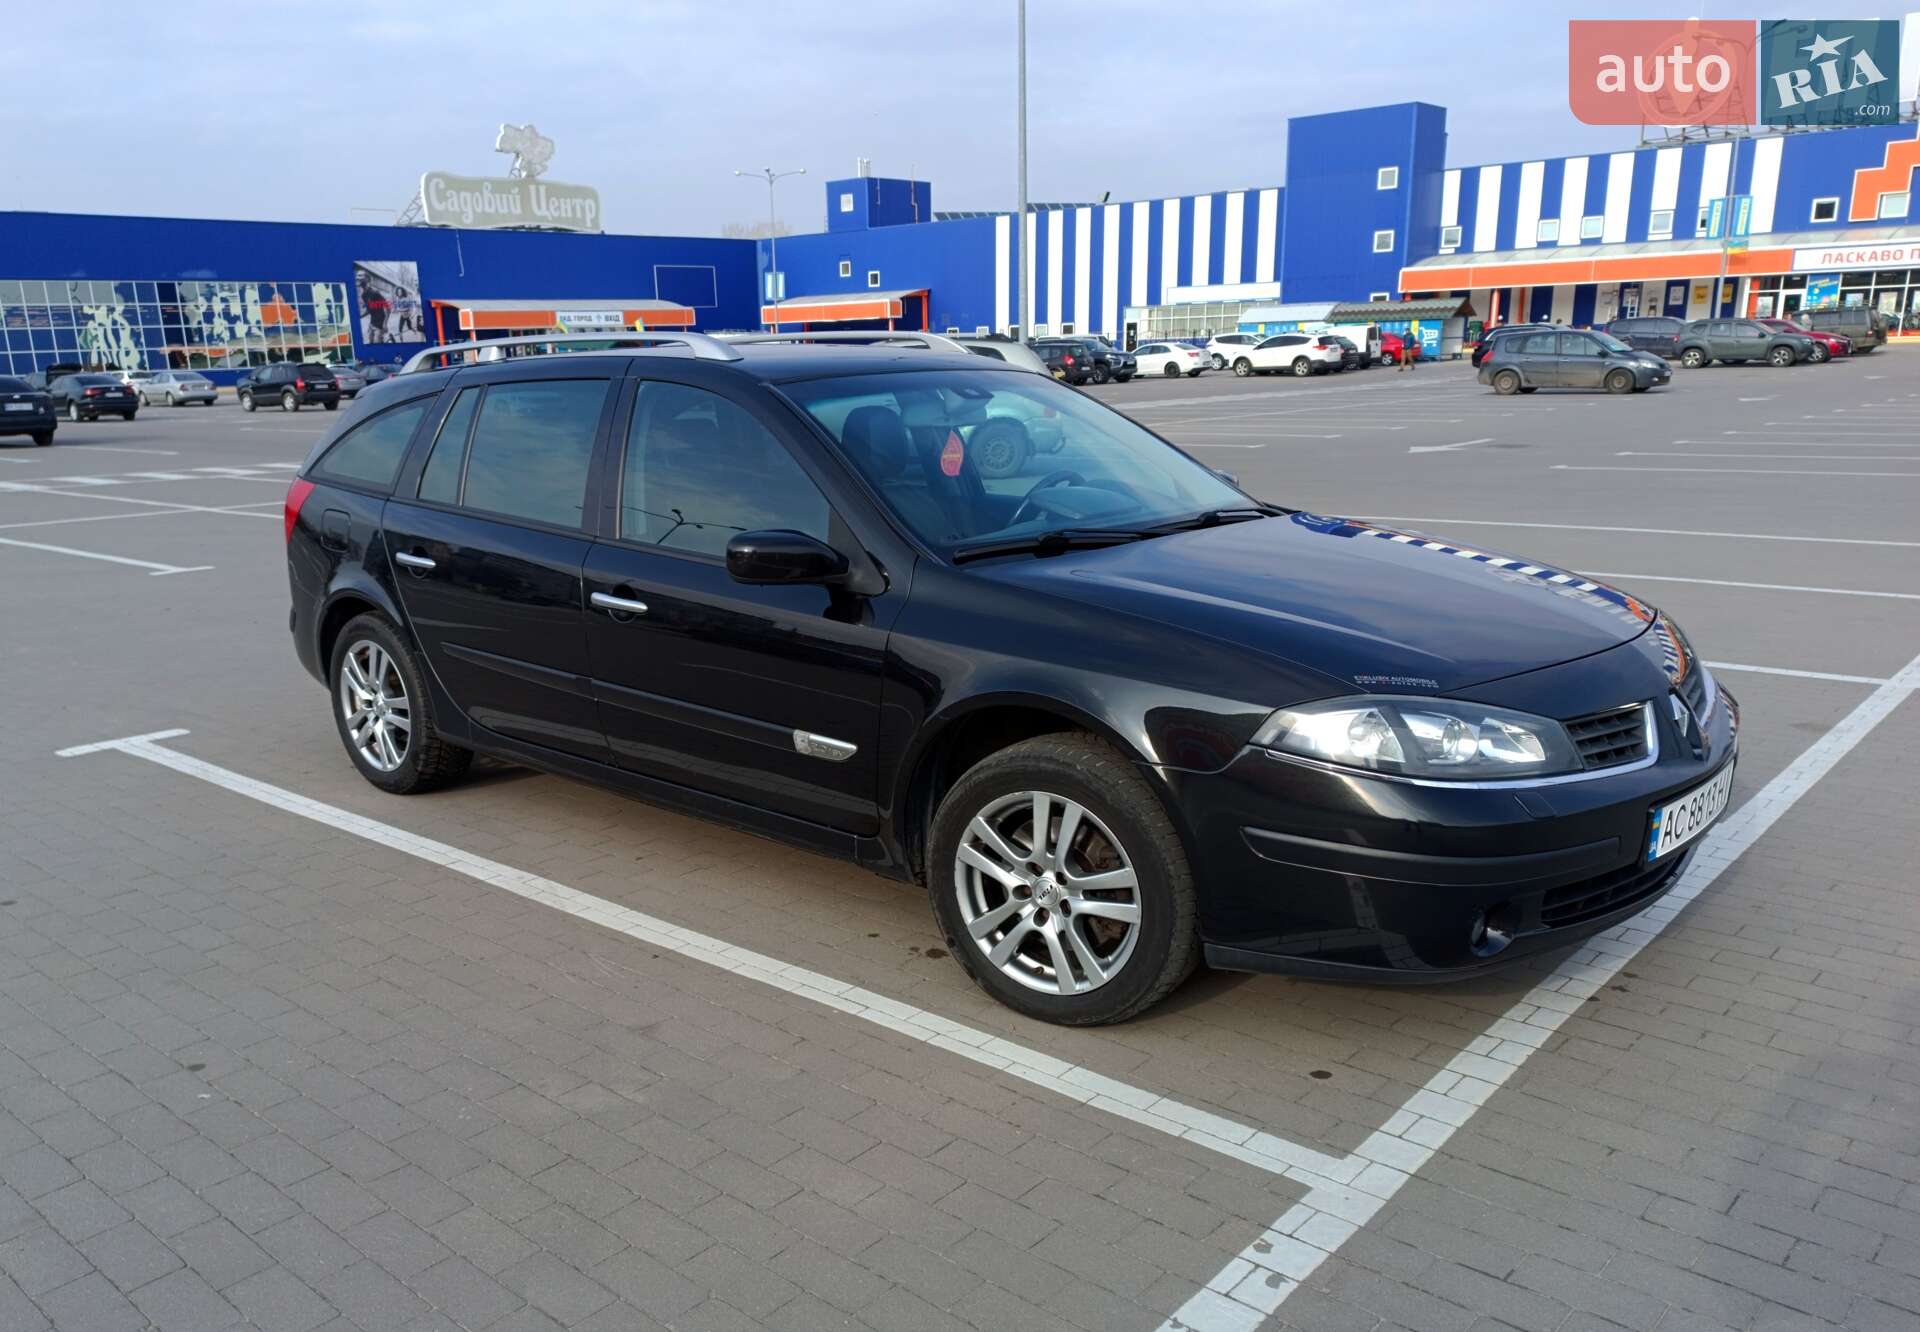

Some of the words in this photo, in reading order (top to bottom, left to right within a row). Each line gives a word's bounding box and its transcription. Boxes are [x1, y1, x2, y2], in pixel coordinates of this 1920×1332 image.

[429, 178, 521, 223] Садовий
[529, 184, 596, 226] Центр
[1821, 249, 1904, 265] ЛАСКАВО
[1660, 804, 1687, 849] AC
